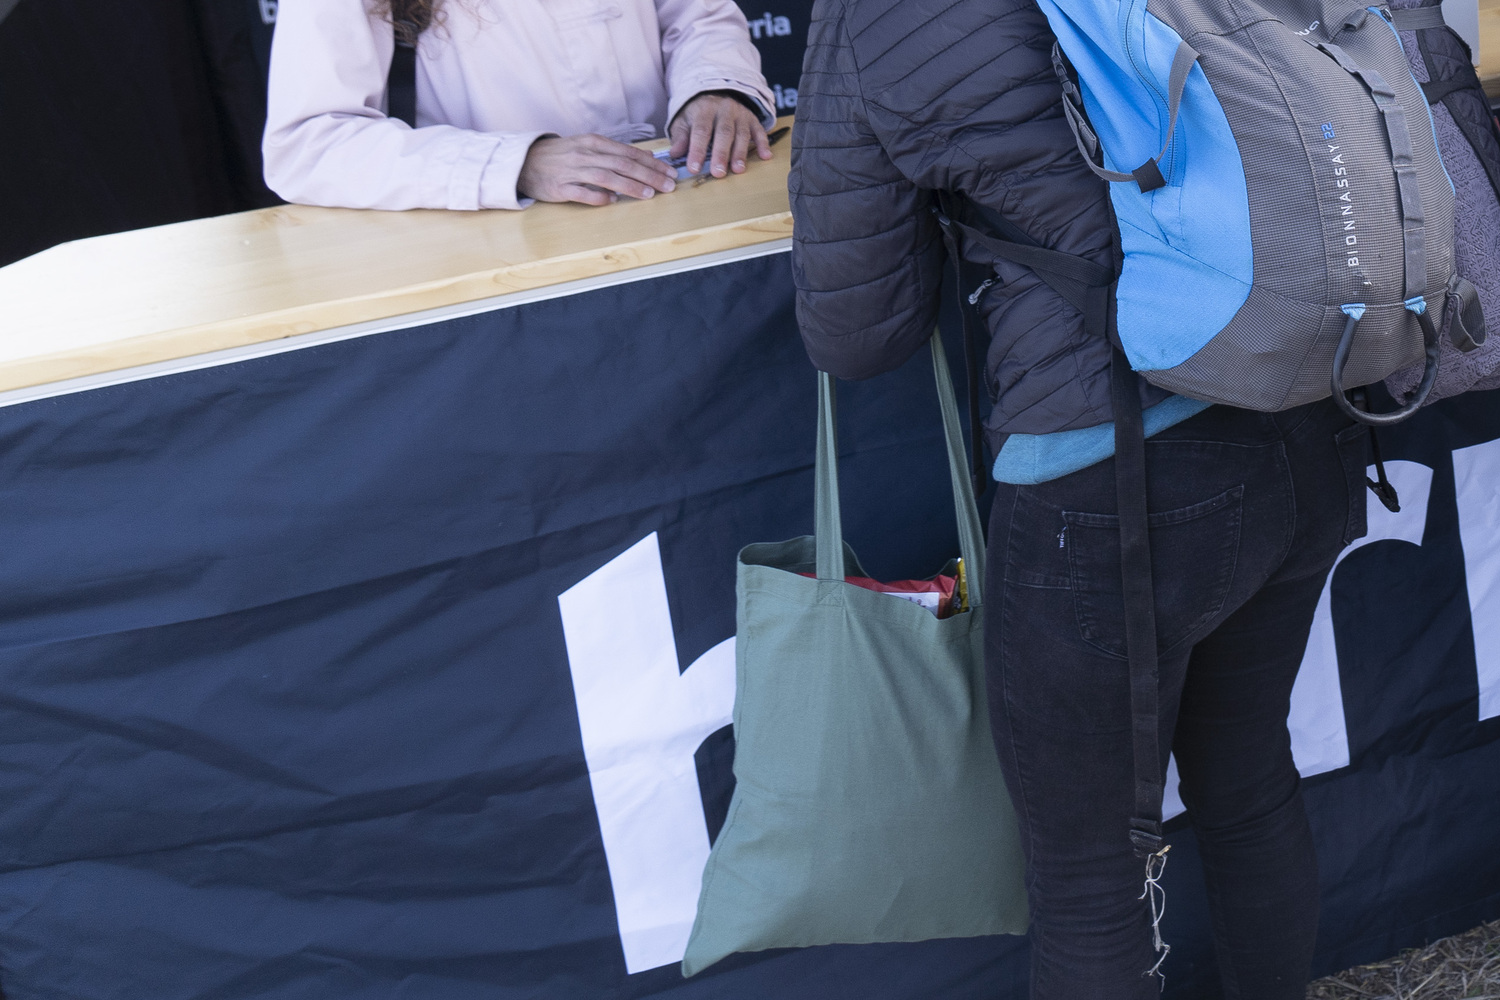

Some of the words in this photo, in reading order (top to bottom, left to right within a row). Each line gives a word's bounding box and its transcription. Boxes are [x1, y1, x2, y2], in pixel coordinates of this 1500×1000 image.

[747, 11, 791, 39] ria
[1320, 121, 1336, 140] 22
[1328, 144, 1359, 267] BIONNASSAY
